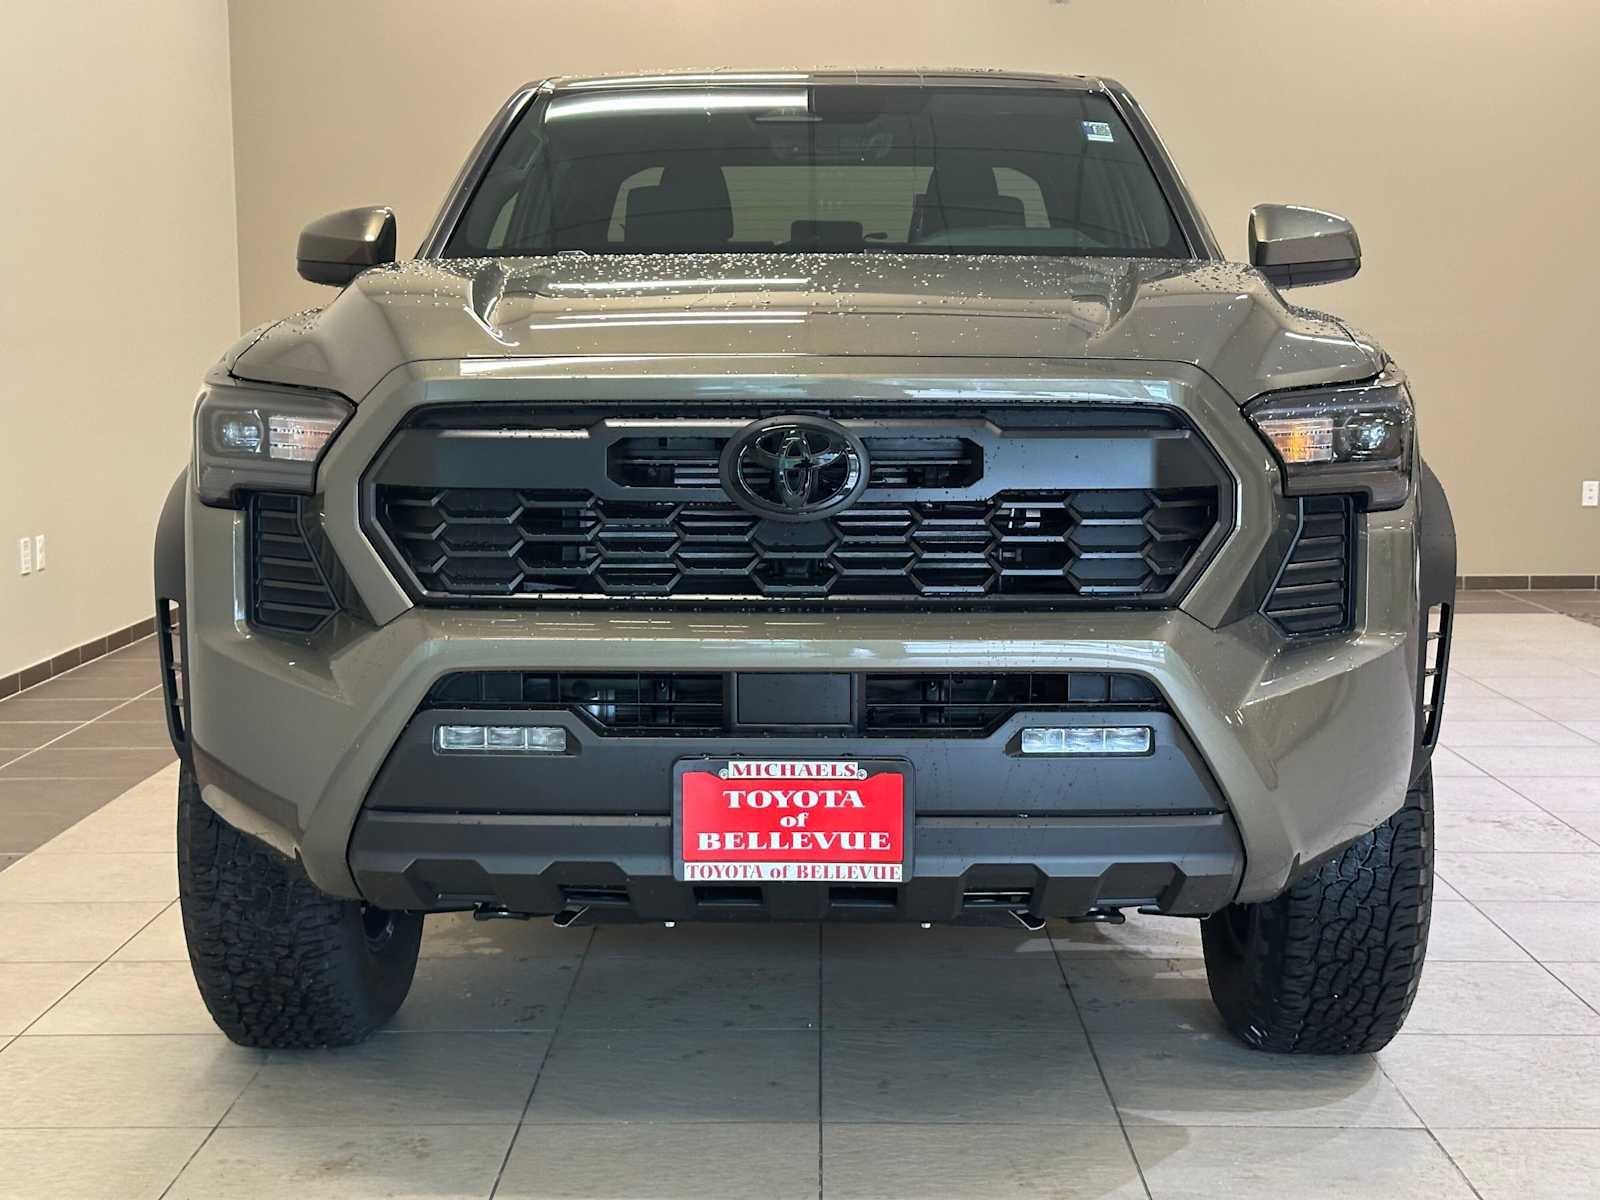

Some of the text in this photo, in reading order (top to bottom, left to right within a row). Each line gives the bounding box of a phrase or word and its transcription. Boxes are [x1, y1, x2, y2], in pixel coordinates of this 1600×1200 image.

[732, 762, 856, 777] MICHAELS
[723, 790, 865, 808] TOYOTA
[780, 812, 809, 828] of
[696, 832, 891, 851] BELLEVUE
[686, 864, 902, 881] TOYOTA of BELLEVUE
